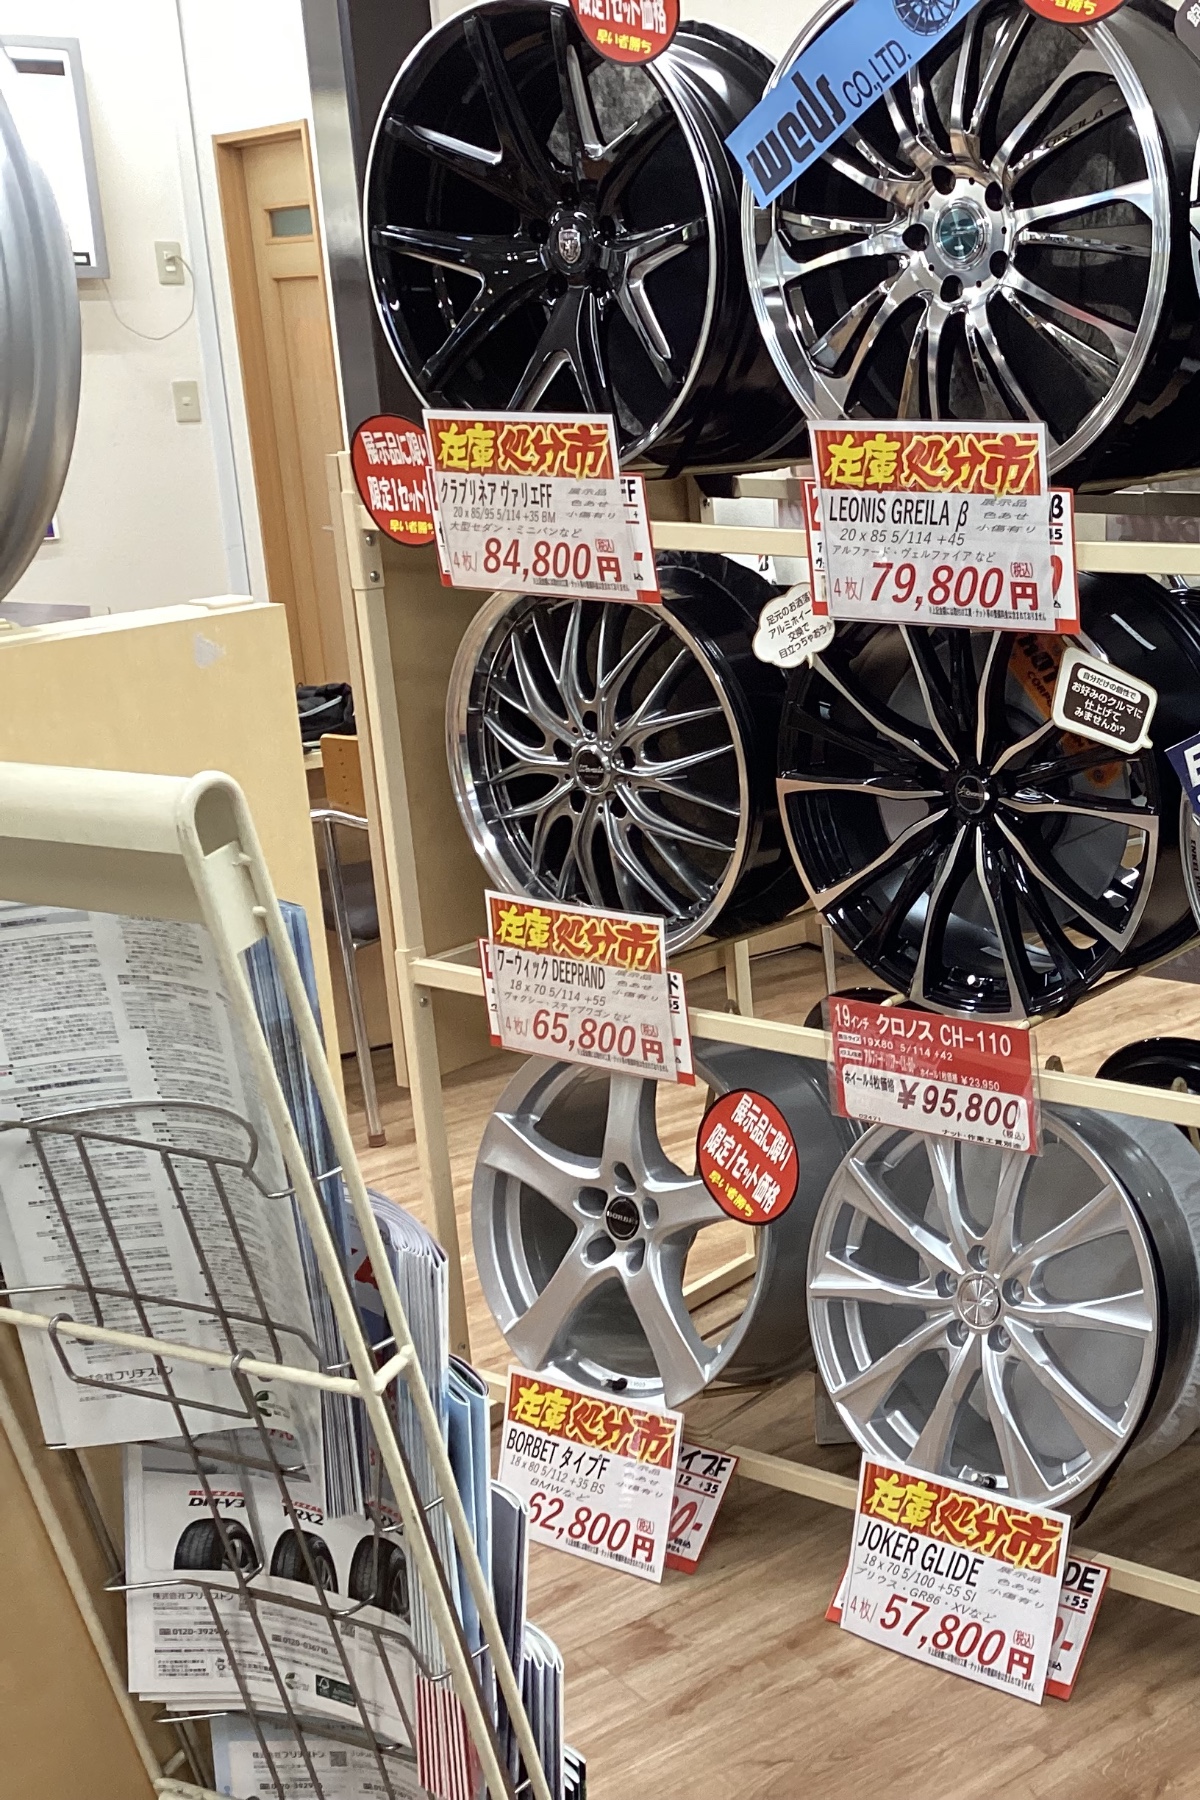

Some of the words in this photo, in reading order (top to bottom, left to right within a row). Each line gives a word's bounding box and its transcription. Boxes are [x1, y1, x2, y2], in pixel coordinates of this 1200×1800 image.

[597, 29, 652, 54] 早い者勝ち
[438, 422, 608, 481] 在庫処分市
[824, 433, 1039, 497] 在庫処分市
[449, 522, 582, 538] 大型セダン・ミニバンなど
[453, 506, 463, 518] 20
[471, 507, 495, 521] 85/95
[496, 510, 521, 522] 5/114
[523, 510, 539, 522] +35
[829, 496, 886, 524] LEONIS
[891, 498, 950, 526] GREILA
[955, 500, 969, 532] β
[983, 511, 1029, 520] 色あせ
[839, 528, 856, 542] 20
[870, 530, 887, 543] 85
[890, 530, 932, 545] 5/114
[937, 532, 965, 546] +45
[788, 622, 810, 642] 交換で
[1072, 681, 1143, 719] お好みのクルマに
[1083, 672, 1137, 700] 自分だけの個性で
[1084, 699, 1121, 722] 仕上げて
[496, 905, 659, 972] 在庫処分市
[498, 950, 548, 982] ワーウィック
[552, 958, 606, 990] DEEPRAND
[510, 979, 521, 991] 18
[534, 984, 546, 995] 70
[549, 985, 580, 1002] 5/114
[585, 996, 606, 1007] +55
[834, 1003, 870, 1030] 19インチ
[877, 1013, 934, 1043] クロノス
[940, 1024, 1012, 1057] CH-110
[862, 1037, 894, 1050] 19X80
[900, 1043, 931, 1057] 5/114
[934, 1050, 953, 1062] +42
[897, 1079, 1021, 1130] ¥95,800
[731, 1093, 793, 1171] 展示品に限り
[709, 1170, 754, 1217] 早い者勝ち
[512, 1382, 676, 1464] 在庫処分市
[506, 1428, 560, 1464] BORBET
[560, 1449, 611, 1479] タイプF
[510, 1455, 520, 1466] 18
[528, 1460, 539, 1473] 80
[540, 1464, 567, 1483] 5/112
[569, 1477, 589, 1490] +35
[590, 1480, 606, 1495] BS
[865, 1473, 1063, 1569] 在庫処分市
[858, 1520, 920, 1567] JOKER
[921, 1543, 985, 1588] GLIDE
[862, 1553, 876, 1568] 18
[886, 1561, 900, 1576] 70
[901, 1566, 936, 1589] 5/100
[938, 1581, 961, 1597] +55
